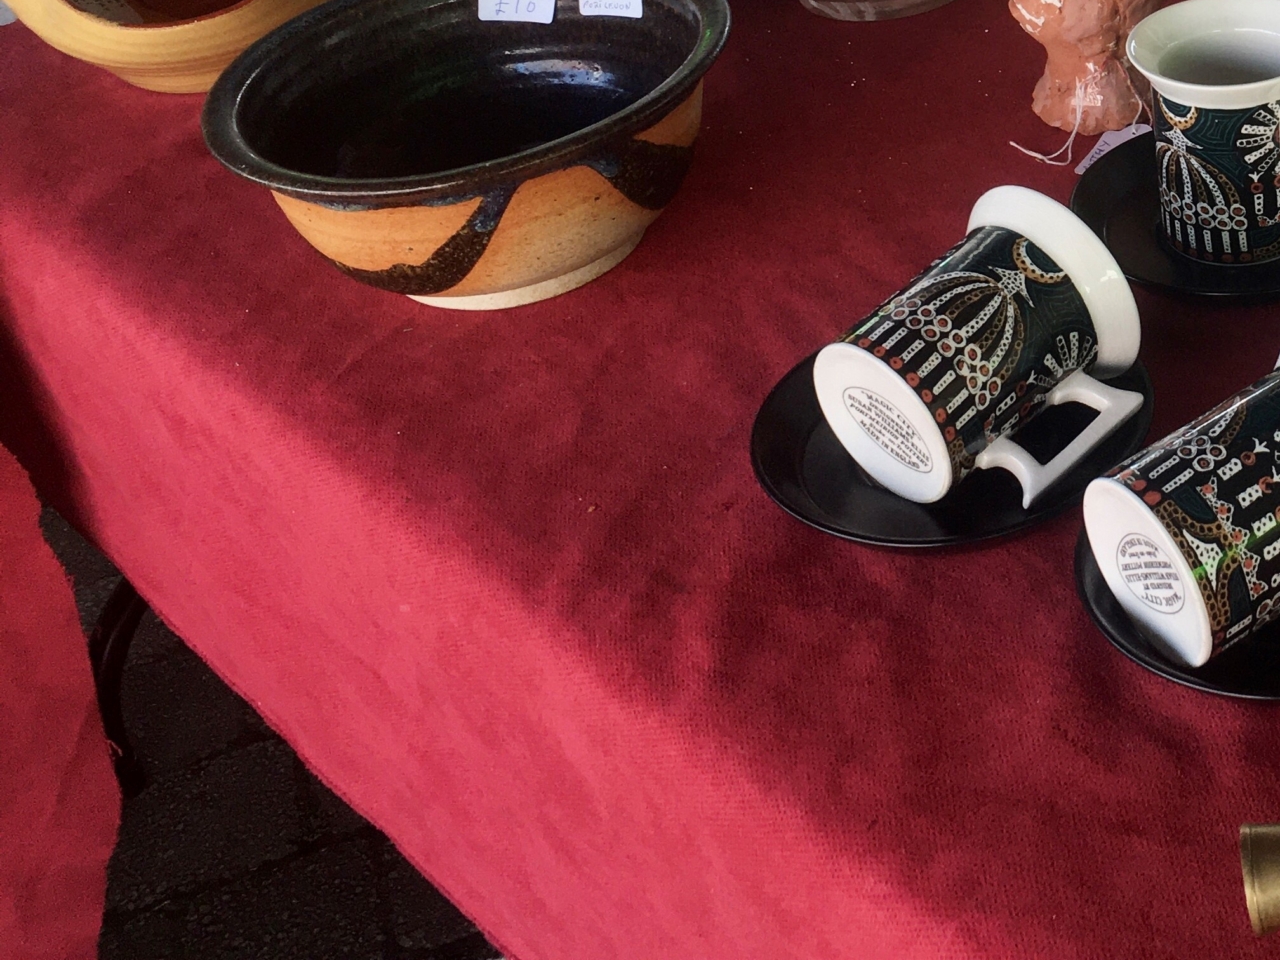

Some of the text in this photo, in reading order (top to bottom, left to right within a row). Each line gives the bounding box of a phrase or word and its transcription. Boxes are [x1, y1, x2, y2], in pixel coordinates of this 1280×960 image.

[848, 394, 872, 412] SUSAN
[868, 400, 914, 440] DESIGNED BY
[850, 402, 929, 468] PORTMEIRION POTTERY
[860, 418, 920, 470] MADE IN ENGLAND
